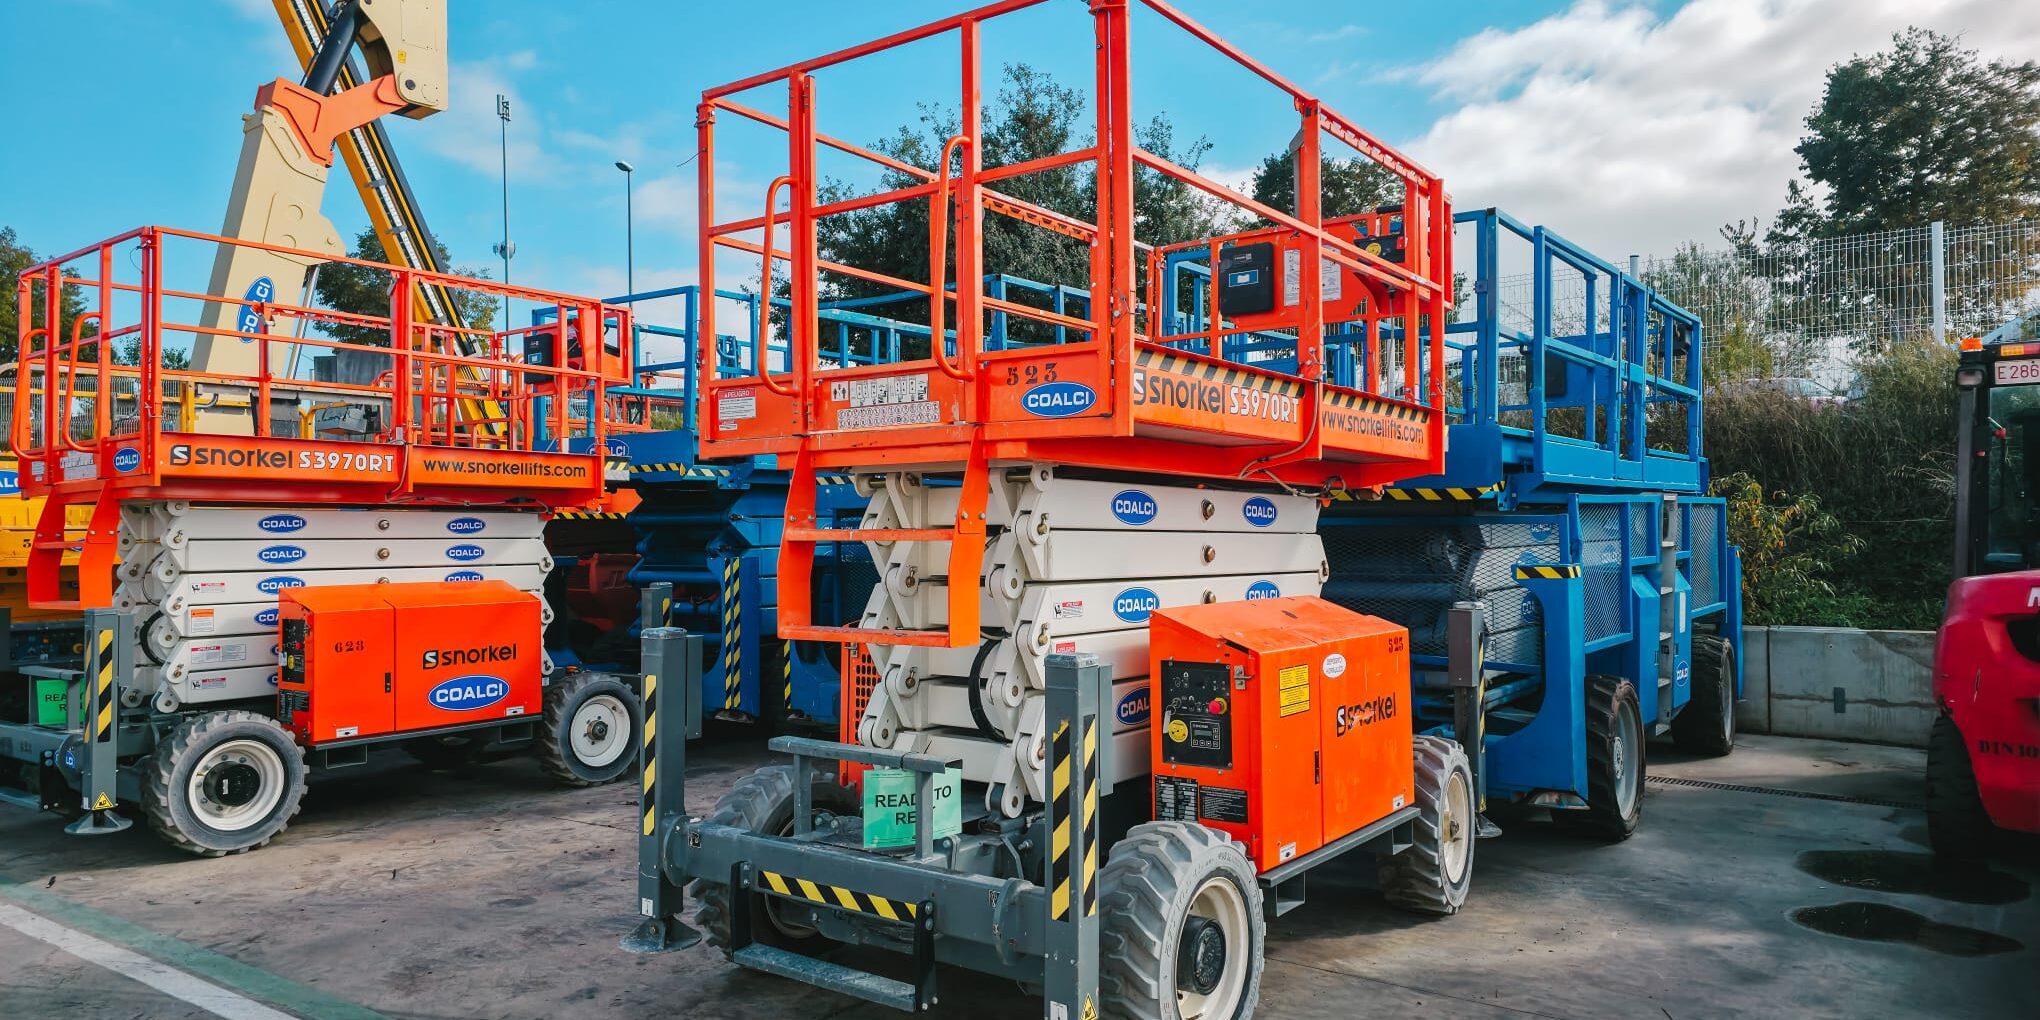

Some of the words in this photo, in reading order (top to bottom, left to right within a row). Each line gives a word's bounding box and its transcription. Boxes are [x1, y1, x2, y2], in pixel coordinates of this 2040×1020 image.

[242, 281, 271, 333] COCI
[1007, 362, 1057, 385] 523
[1027, 391, 1089, 408] COALCI
[1149, 375, 1226, 414] snorkel
[1229, 385, 1299, 424] S3970RT
[115, 453, 139, 466] COALCI
[195, 448, 293, 468] snorkel
[299, 450, 394, 472] S3970RT
[423, 459, 586, 477] www.snorkellifts.com
[1115, 499, 1155, 515] COALCI
[1245, 504, 1275, 519] COALCI
[262, 519, 303, 528] COALCI
[449, 522, 483, 530] COALCI
[261, 550, 303, 559] COALCI
[448, 549, 482, 557] COALCI
[1117, 597, 1156, 613] COALCI
[441, 643, 517, 666] snorkel
[435, 682, 503, 703] COALCI
[1120, 697, 1150, 718] COAL
[934, 785, 952, 800] TO
